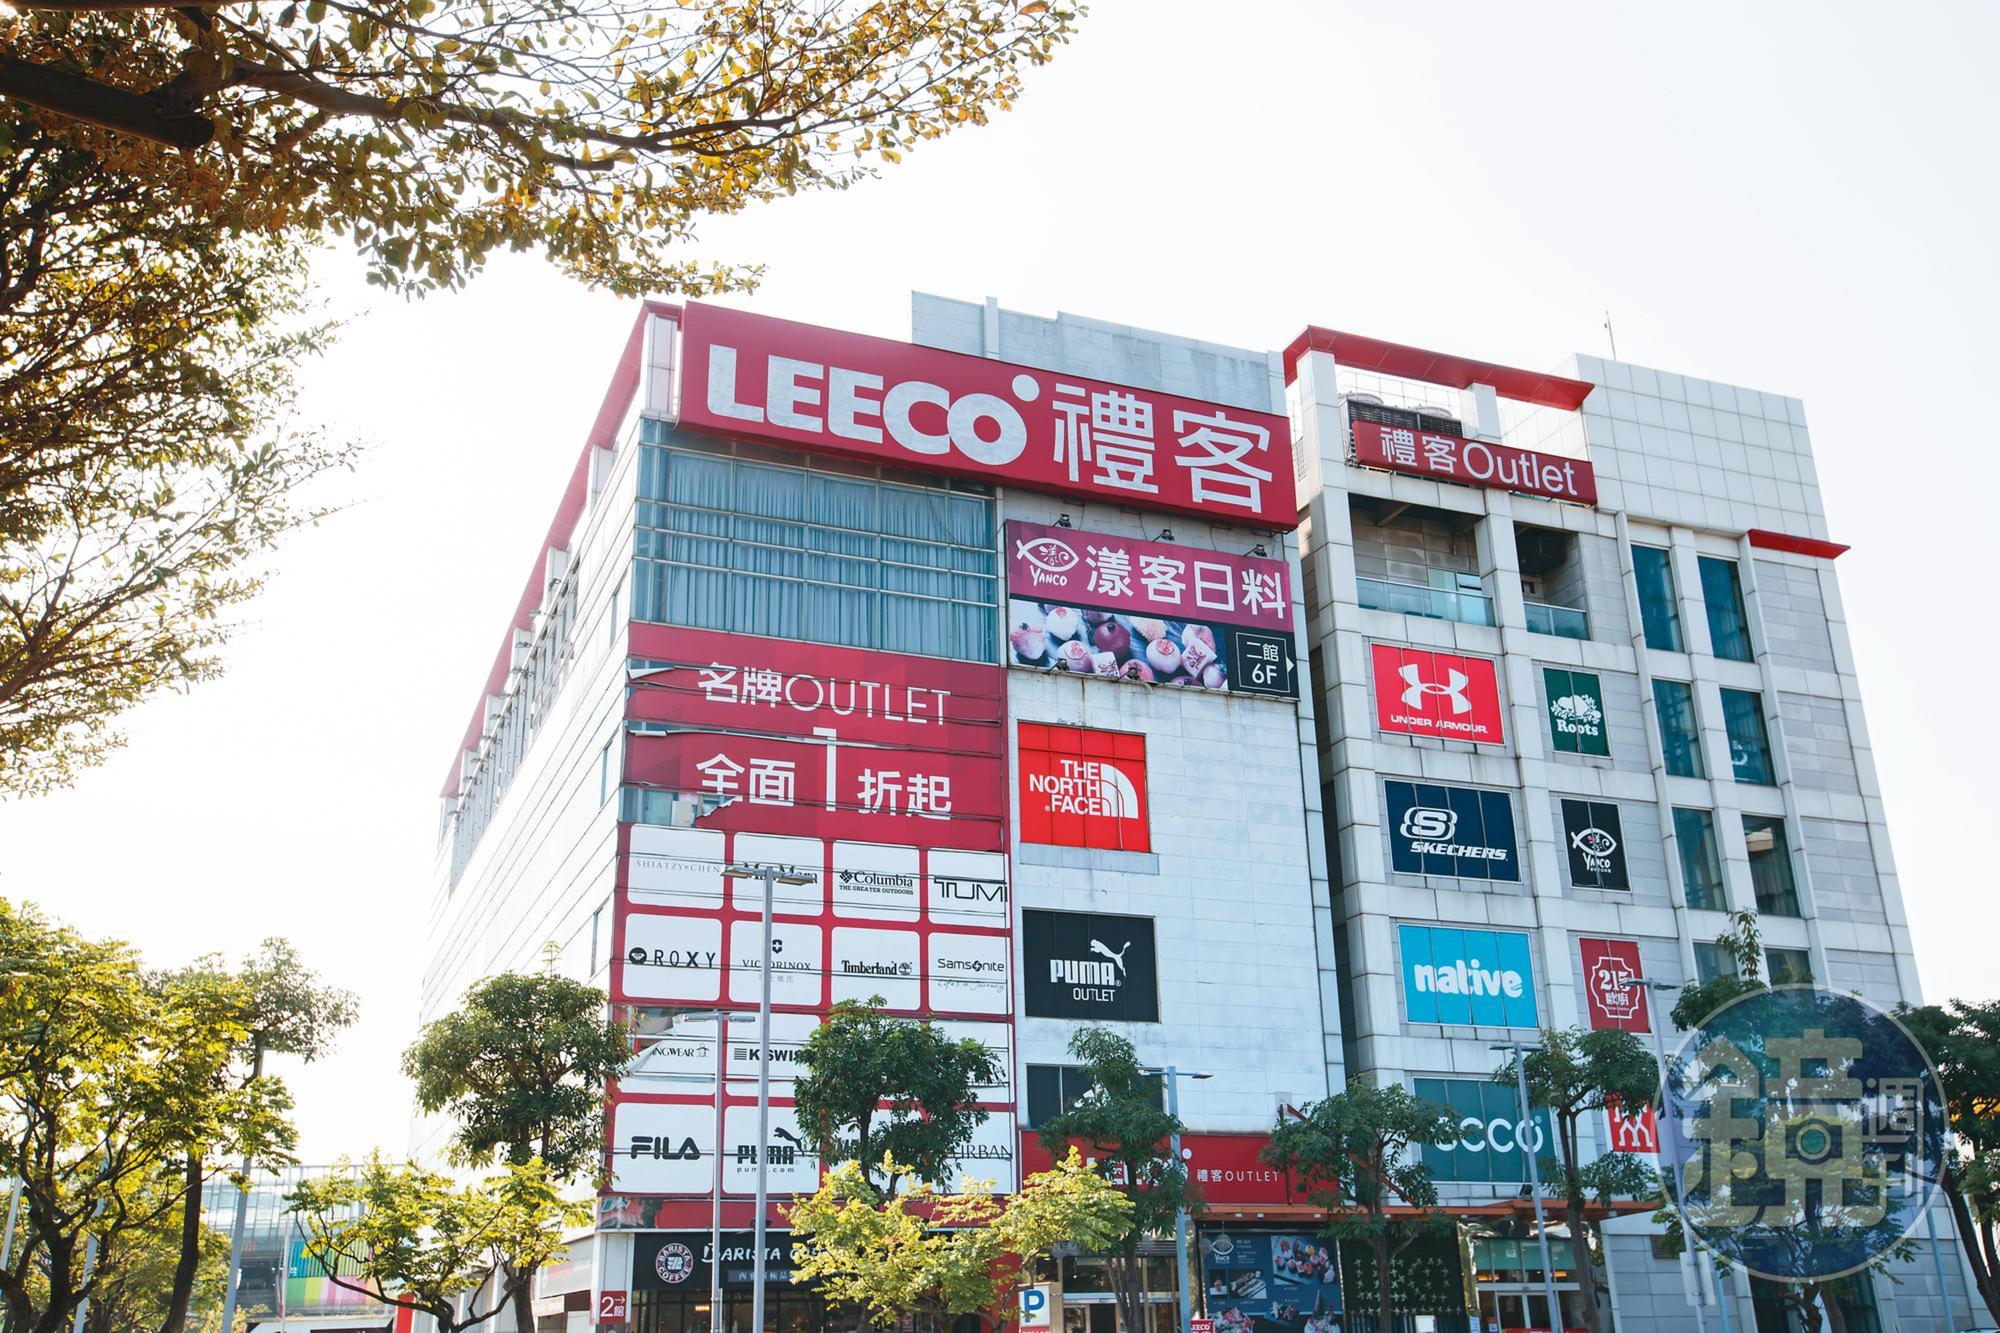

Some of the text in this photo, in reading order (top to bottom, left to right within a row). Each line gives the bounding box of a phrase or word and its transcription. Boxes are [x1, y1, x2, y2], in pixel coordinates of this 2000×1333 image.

[707, 343, 1029, 466] LEECO
[1051, 383, 1273, 514] 禮客
[1086, 544, 1287, 619] 漾客日料
[1246, 641, 1280, 663] 二館
[1251, 663, 1278, 685] 6F
[1391, 714, 1487, 734] UNDER ARMOUR
[1557, 719, 1598, 736] Roots
[1060, 759, 1099, 780] THE
[1029, 774, 1101, 798] NORTH
[1051, 796, 1101, 817] FACE
[1410, 840, 1507, 861] SKECHERS
[854, 871, 914, 888] Columbia
[934, 876, 1008, 903] TUMI
[852, 885, 881, 893] GREATER
[882, 887, 914, 896] OUTDOORS
[654, 949, 716, 968] ROXY
[742, 959, 812, 971] VICORINOX
[841, 959, 897, 976] Timberland
[937, 958, 1005, 972] Samsonite
[1050, 958, 1116, 986] PUMA
[1413, 958, 1523, 998] native
[1072, 987, 1116, 1002] OUTLET
[631, 1136, 701, 1160] FILA
[1024, 1290, 1045, 1323] P
